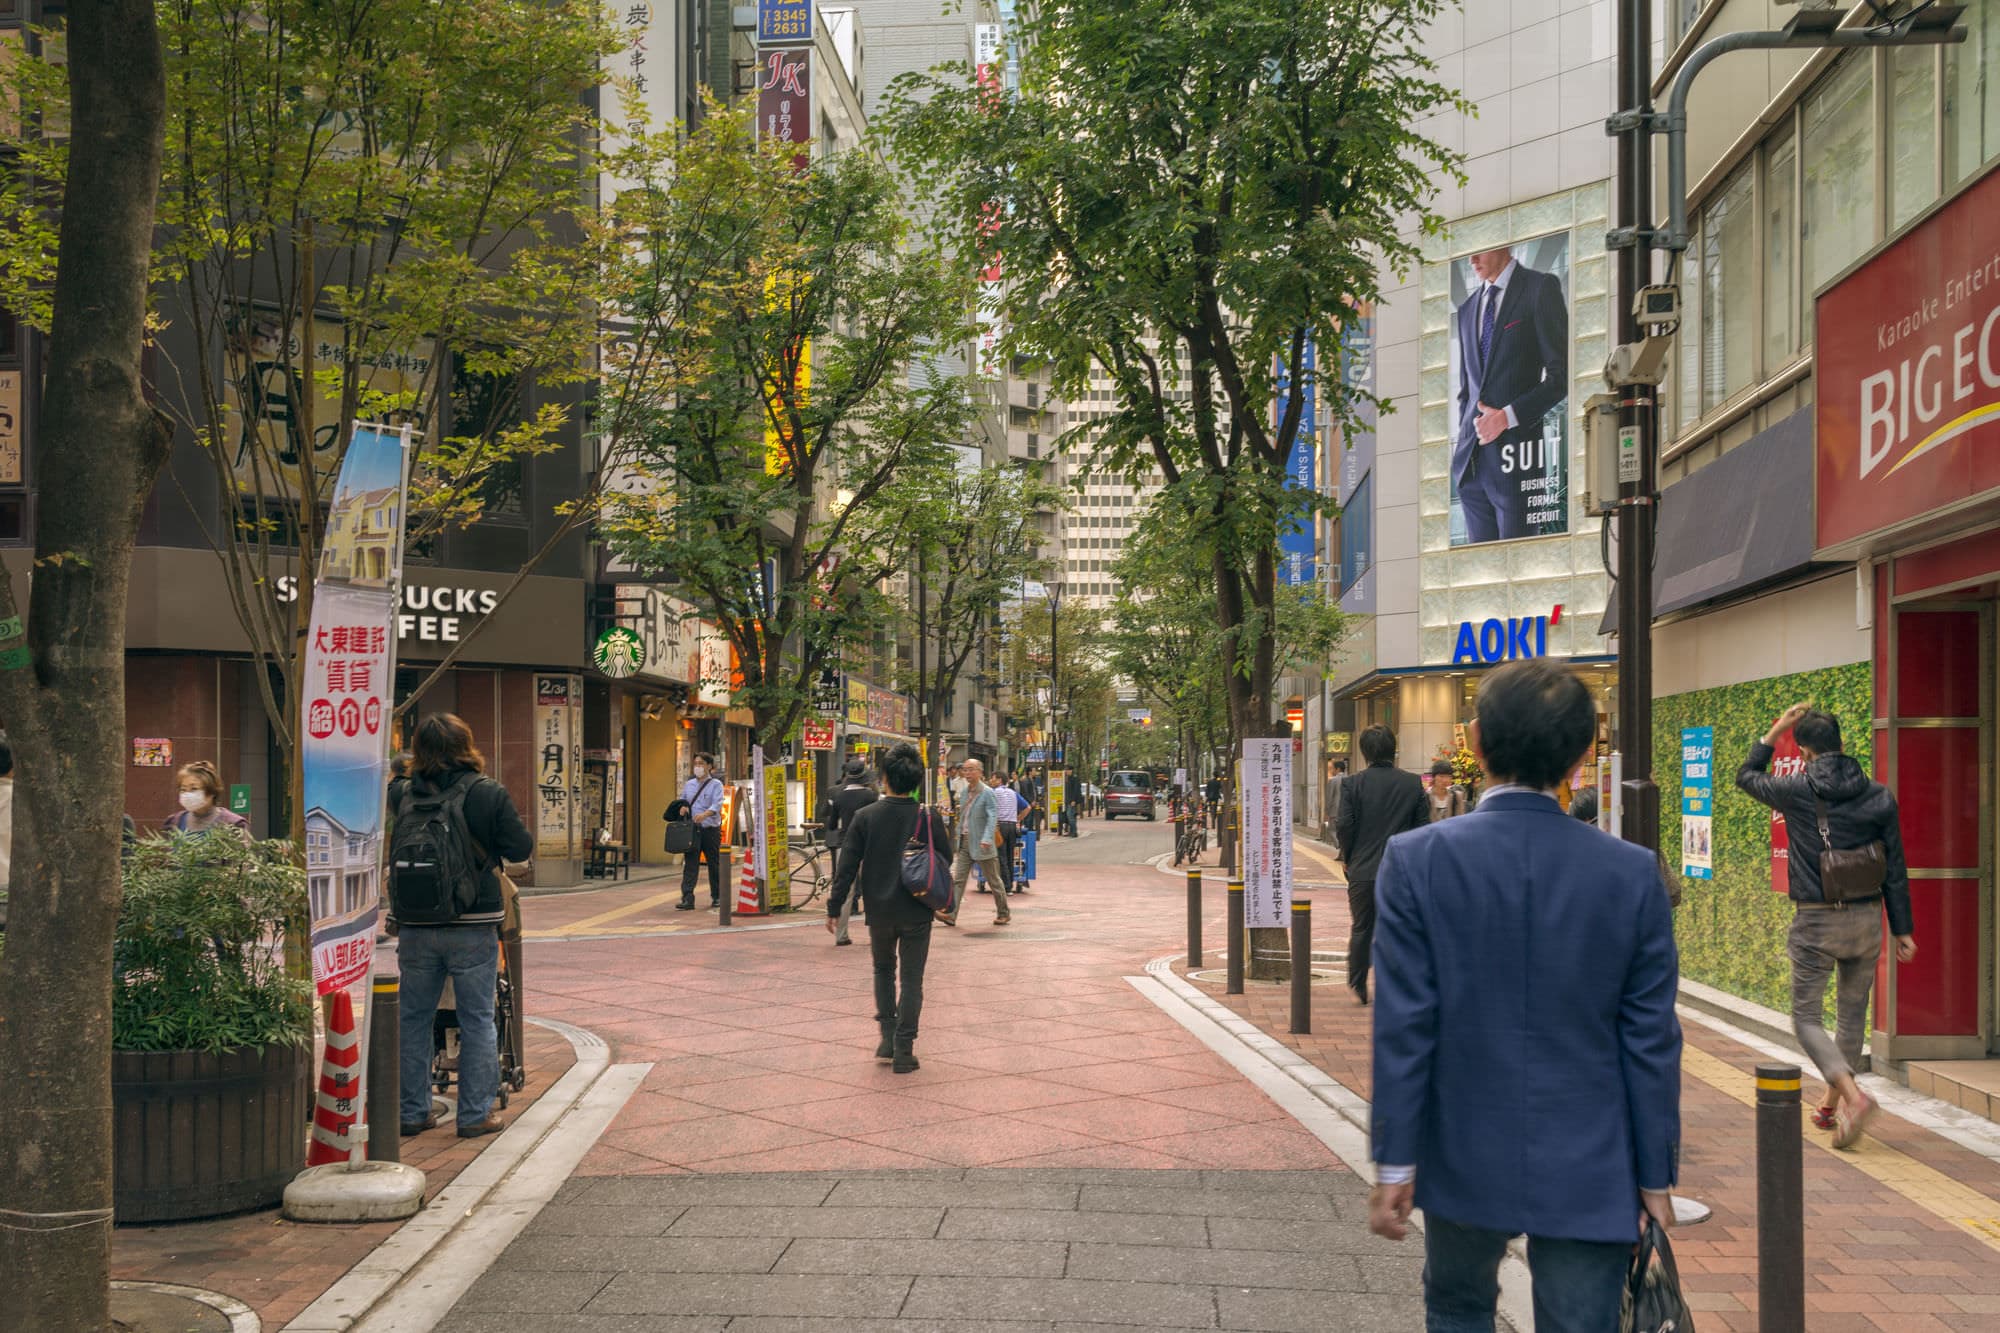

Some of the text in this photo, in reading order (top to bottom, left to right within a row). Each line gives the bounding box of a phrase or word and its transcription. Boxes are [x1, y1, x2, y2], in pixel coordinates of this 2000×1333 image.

[774, 9, 807, 21] 3345
[774, 22, 806, 34] 2631
[1878, 296, 1938, 352] Karaoke
[1860, 345, 1942, 480] BIG
[1501, 437, 1561, 474] SUIT
[1521, 476, 1560, 491] BUSINESS
[1528, 492, 1560, 507] FORMAL
[1526, 510, 1560, 524] RECRUIT
[276, 576, 498, 614] SUCKS
[315, 625, 385, 655] 大東建託
[1453, 616, 1547, 664] AOKI
[309, 701, 380, 734] 紹介中
